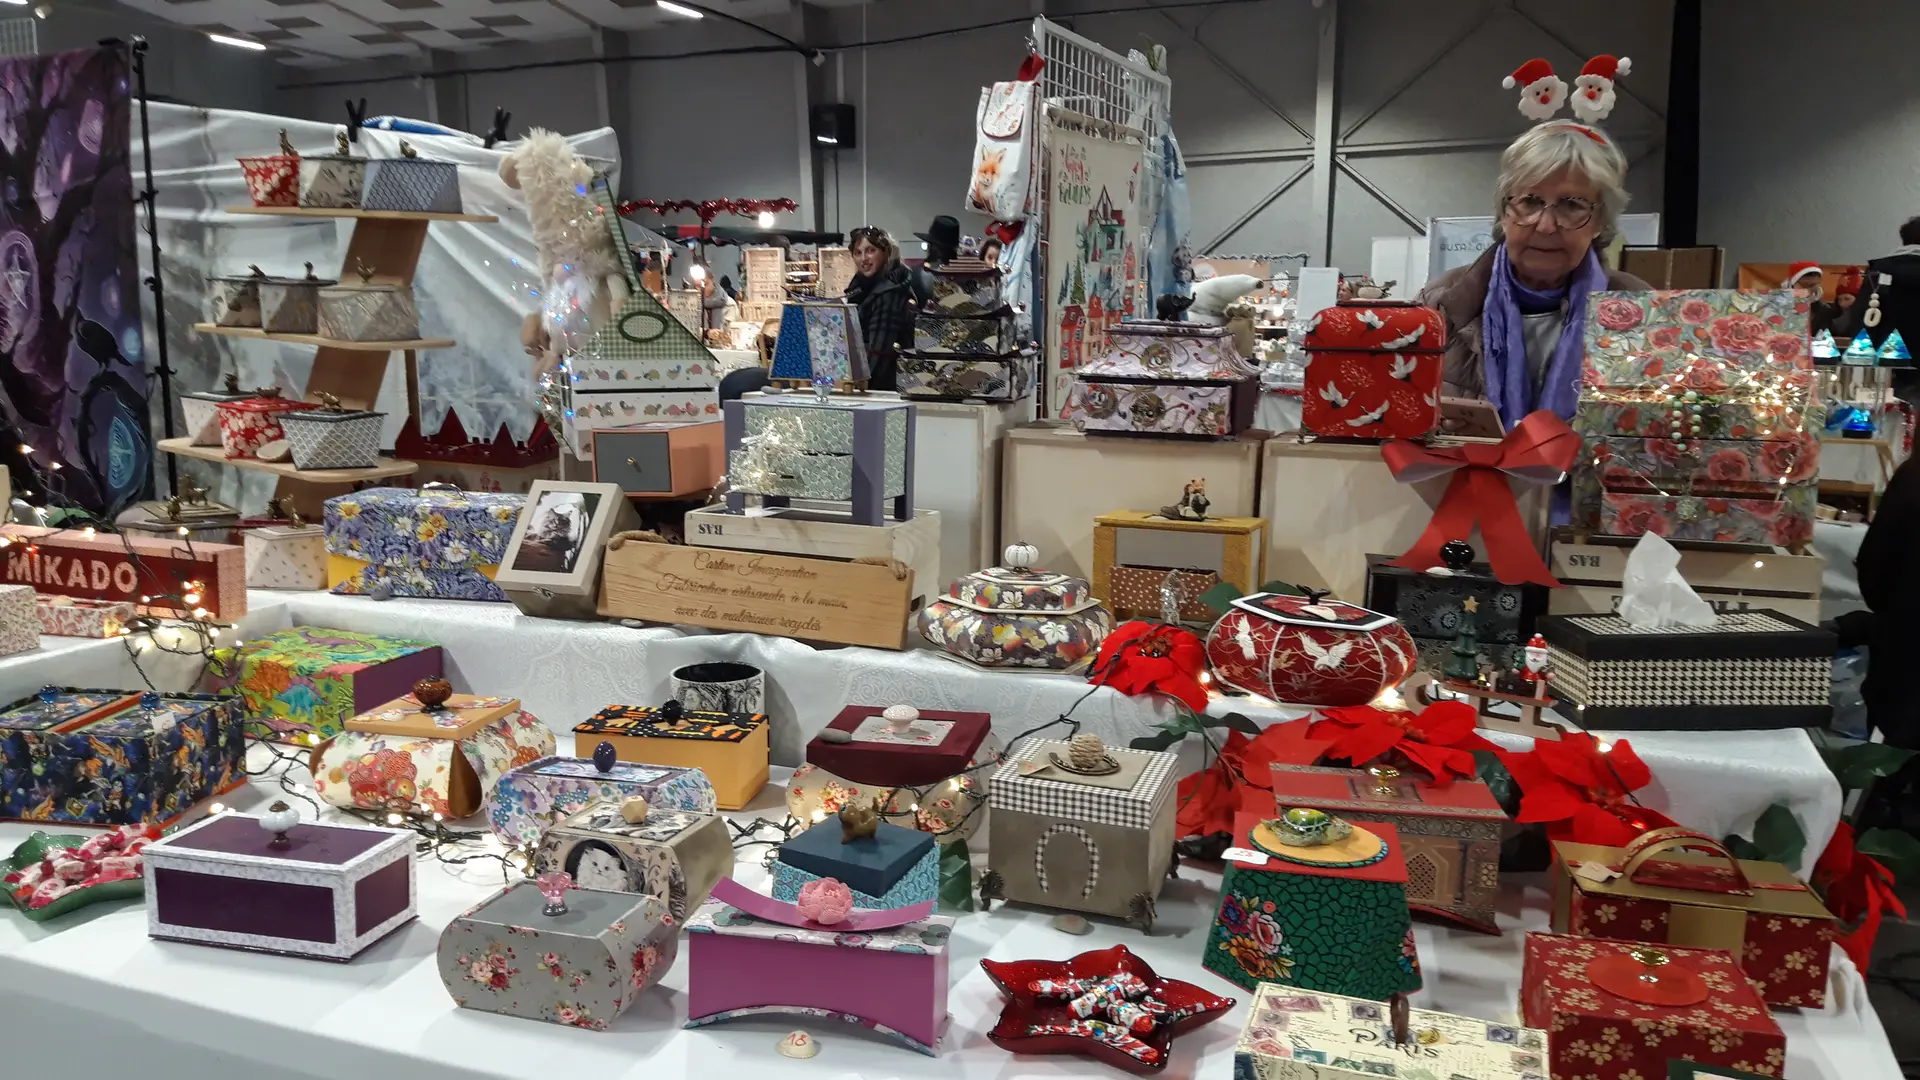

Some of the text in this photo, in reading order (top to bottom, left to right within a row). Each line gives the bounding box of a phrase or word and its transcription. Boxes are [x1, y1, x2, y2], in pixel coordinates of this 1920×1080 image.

[697, 523, 723, 535] BAS
[6, 551, 138, 594] MIKADO
[693, 551, 818, 582] Carton Imagination
[1569, 554, 1600, 567] BAS
[656, 572, 728, 596] Fabrication
[786, 1032, 807, 1047] 18
[1348, 1027, 1440, 1058] PARIS
